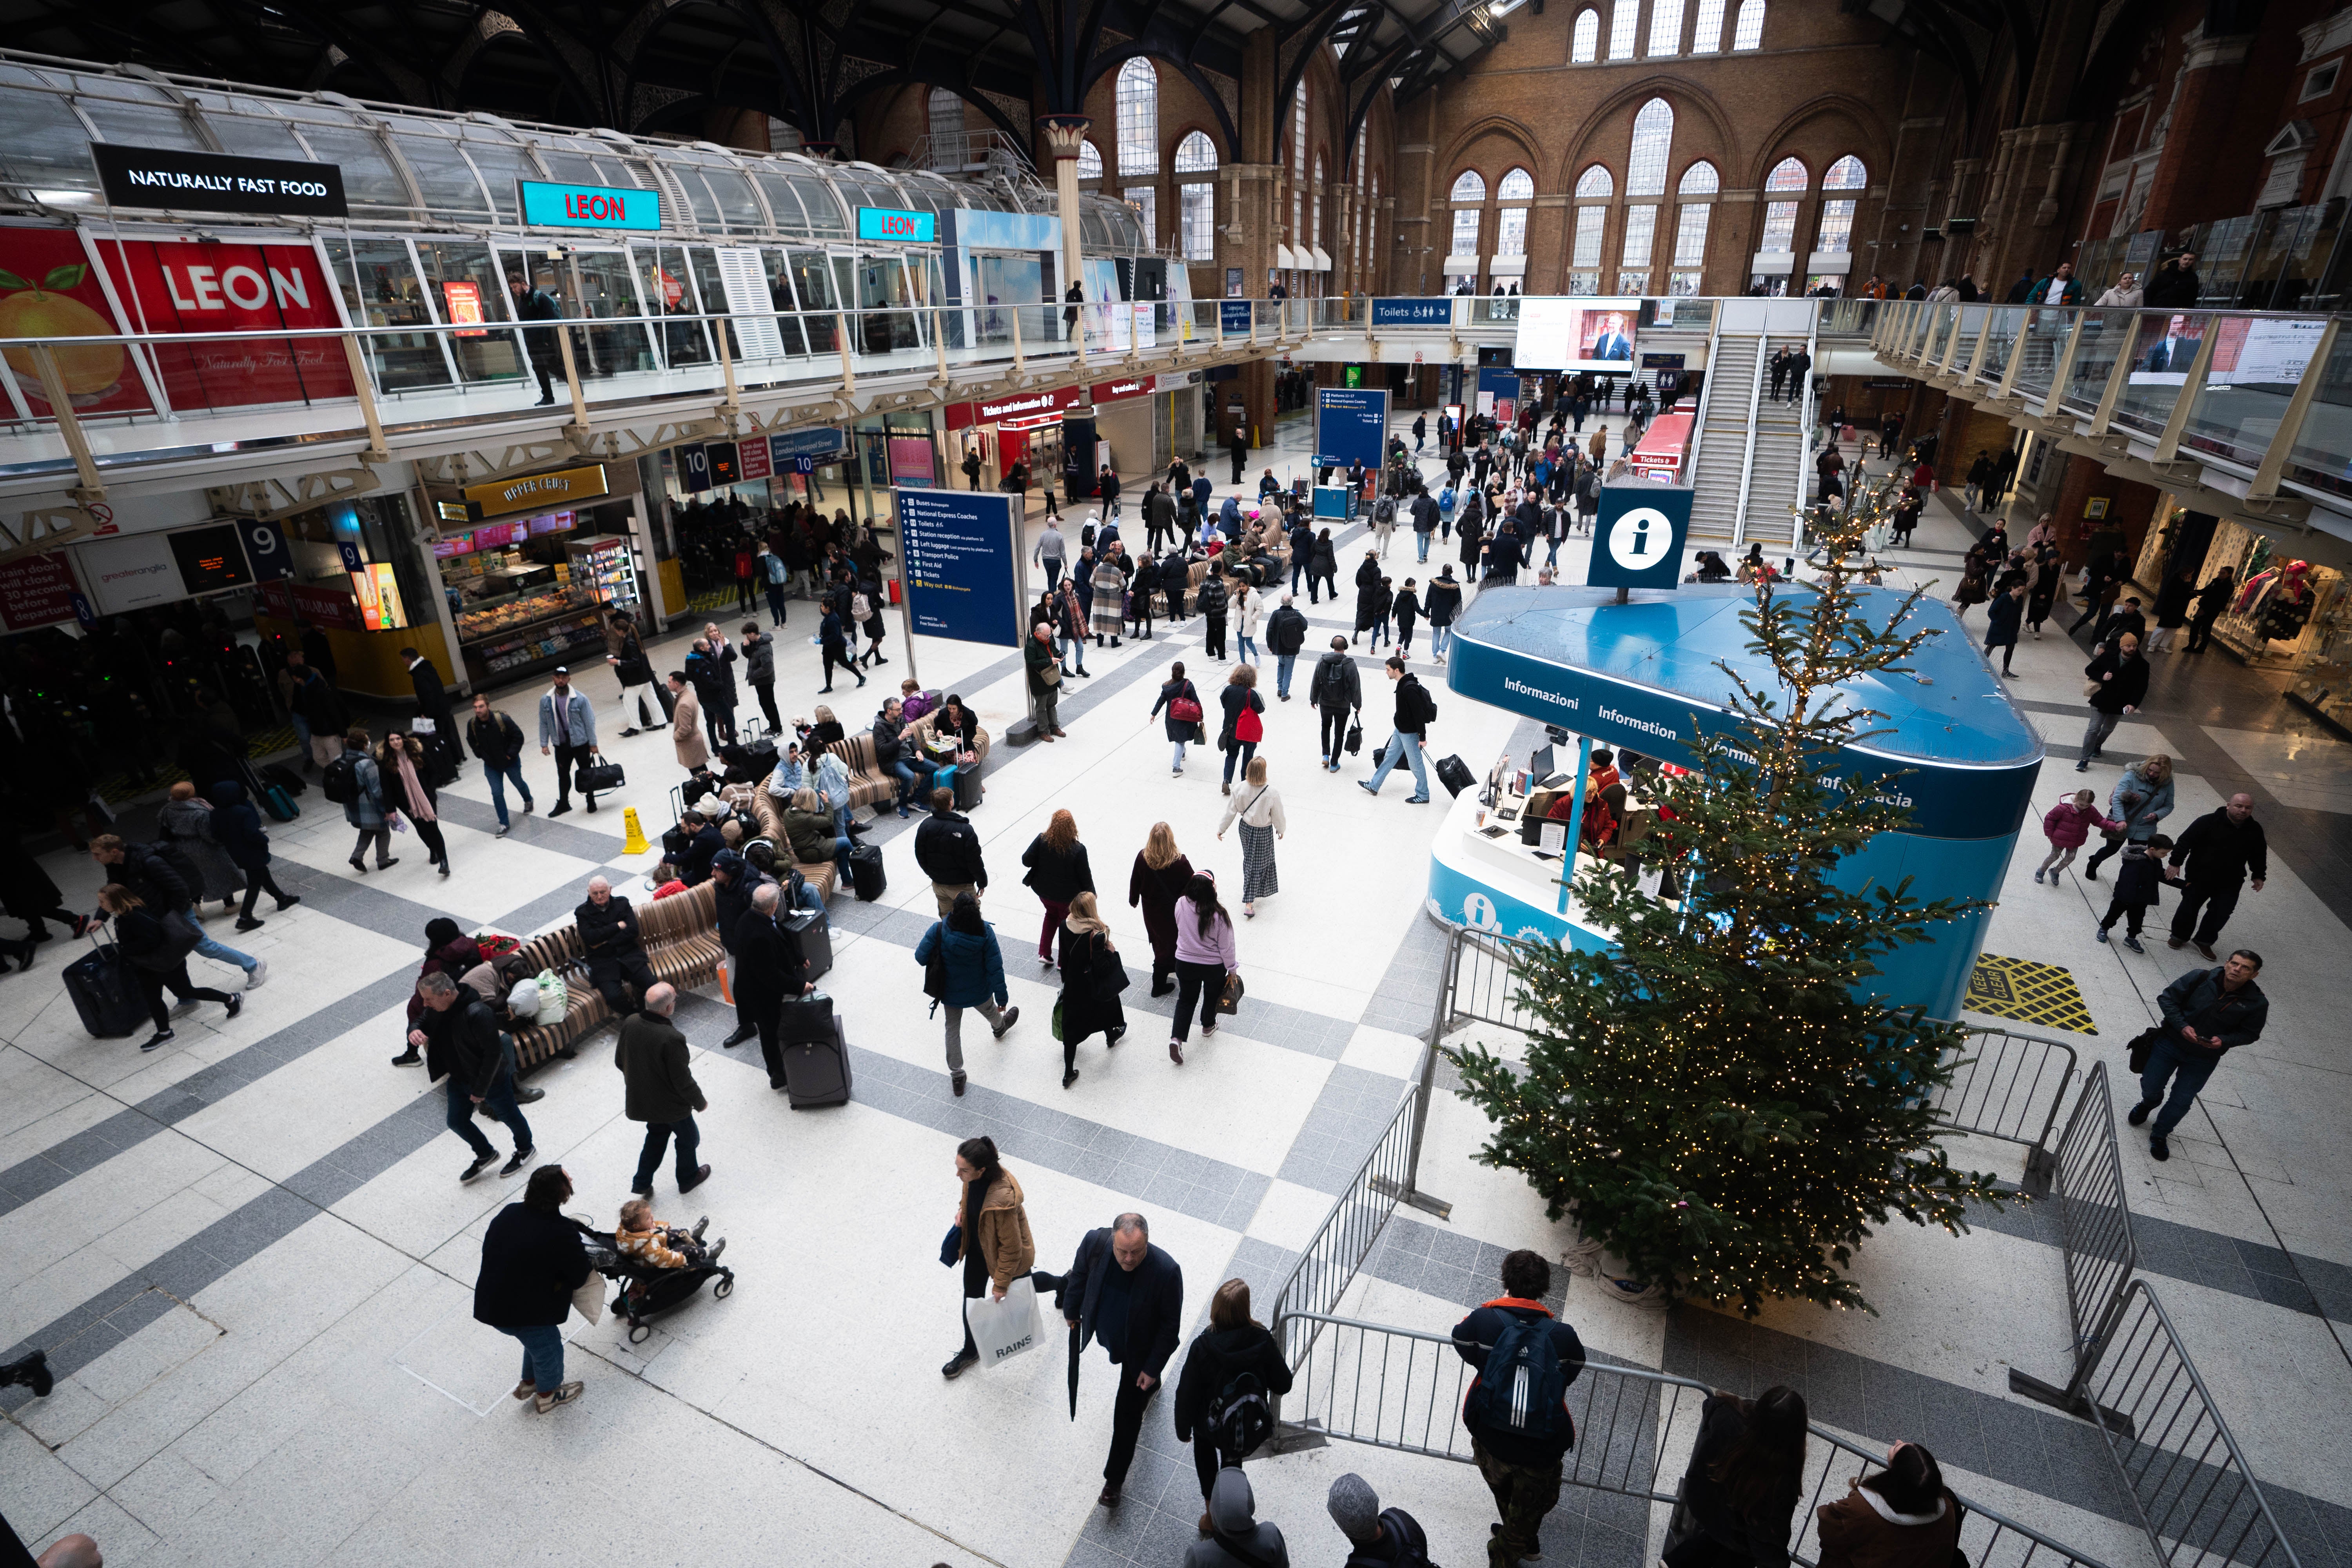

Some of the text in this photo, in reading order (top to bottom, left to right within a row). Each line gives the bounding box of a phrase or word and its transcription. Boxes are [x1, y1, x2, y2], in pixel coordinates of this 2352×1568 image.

[129, 170, 327, 196] NATURALLY FAST FOOD
[565, 193, 626, 221] LEON
[882, 216, 914, 235] LEON
[162, 265, 310, 310] LEON
[1379, 307, 1409, 316] Toilets
[200, 351, 325, 374] Naturally Fast Food
[982, 398, 1041, 417] Tickets and information
[775, 439, 832, 456] London Liverpool Street
[686, 452, 706, 474] 10
[746, 468, 766, 476] departure
[797, 457, 811, 470] 10
[503, 478, 571, 502] UPPER CRUST
[252, 526, 277, 555] 9
[345, 546, 356, 565] 9
[921, 551, 944, 559] Transport
[28, 563, 62, 574] doors
[102, 563, 167, 583] greateranglia
[0, 575, 55, 590] will close
[4, 583, 72, 601] 30 seconds
[9, 598, 49, 611] before
[14, 605, 73, 622] departure
[76, 599, 89, 620] 8
[1504, 677, 1579, 710] Informazioni
[1598, 705, 1677, 740] Information
[1972, 970, 1989, 993] KEEP
[1987, 971, 2008, 999] CLEAR
[996, 1335, 1032, 1358] RAINS
